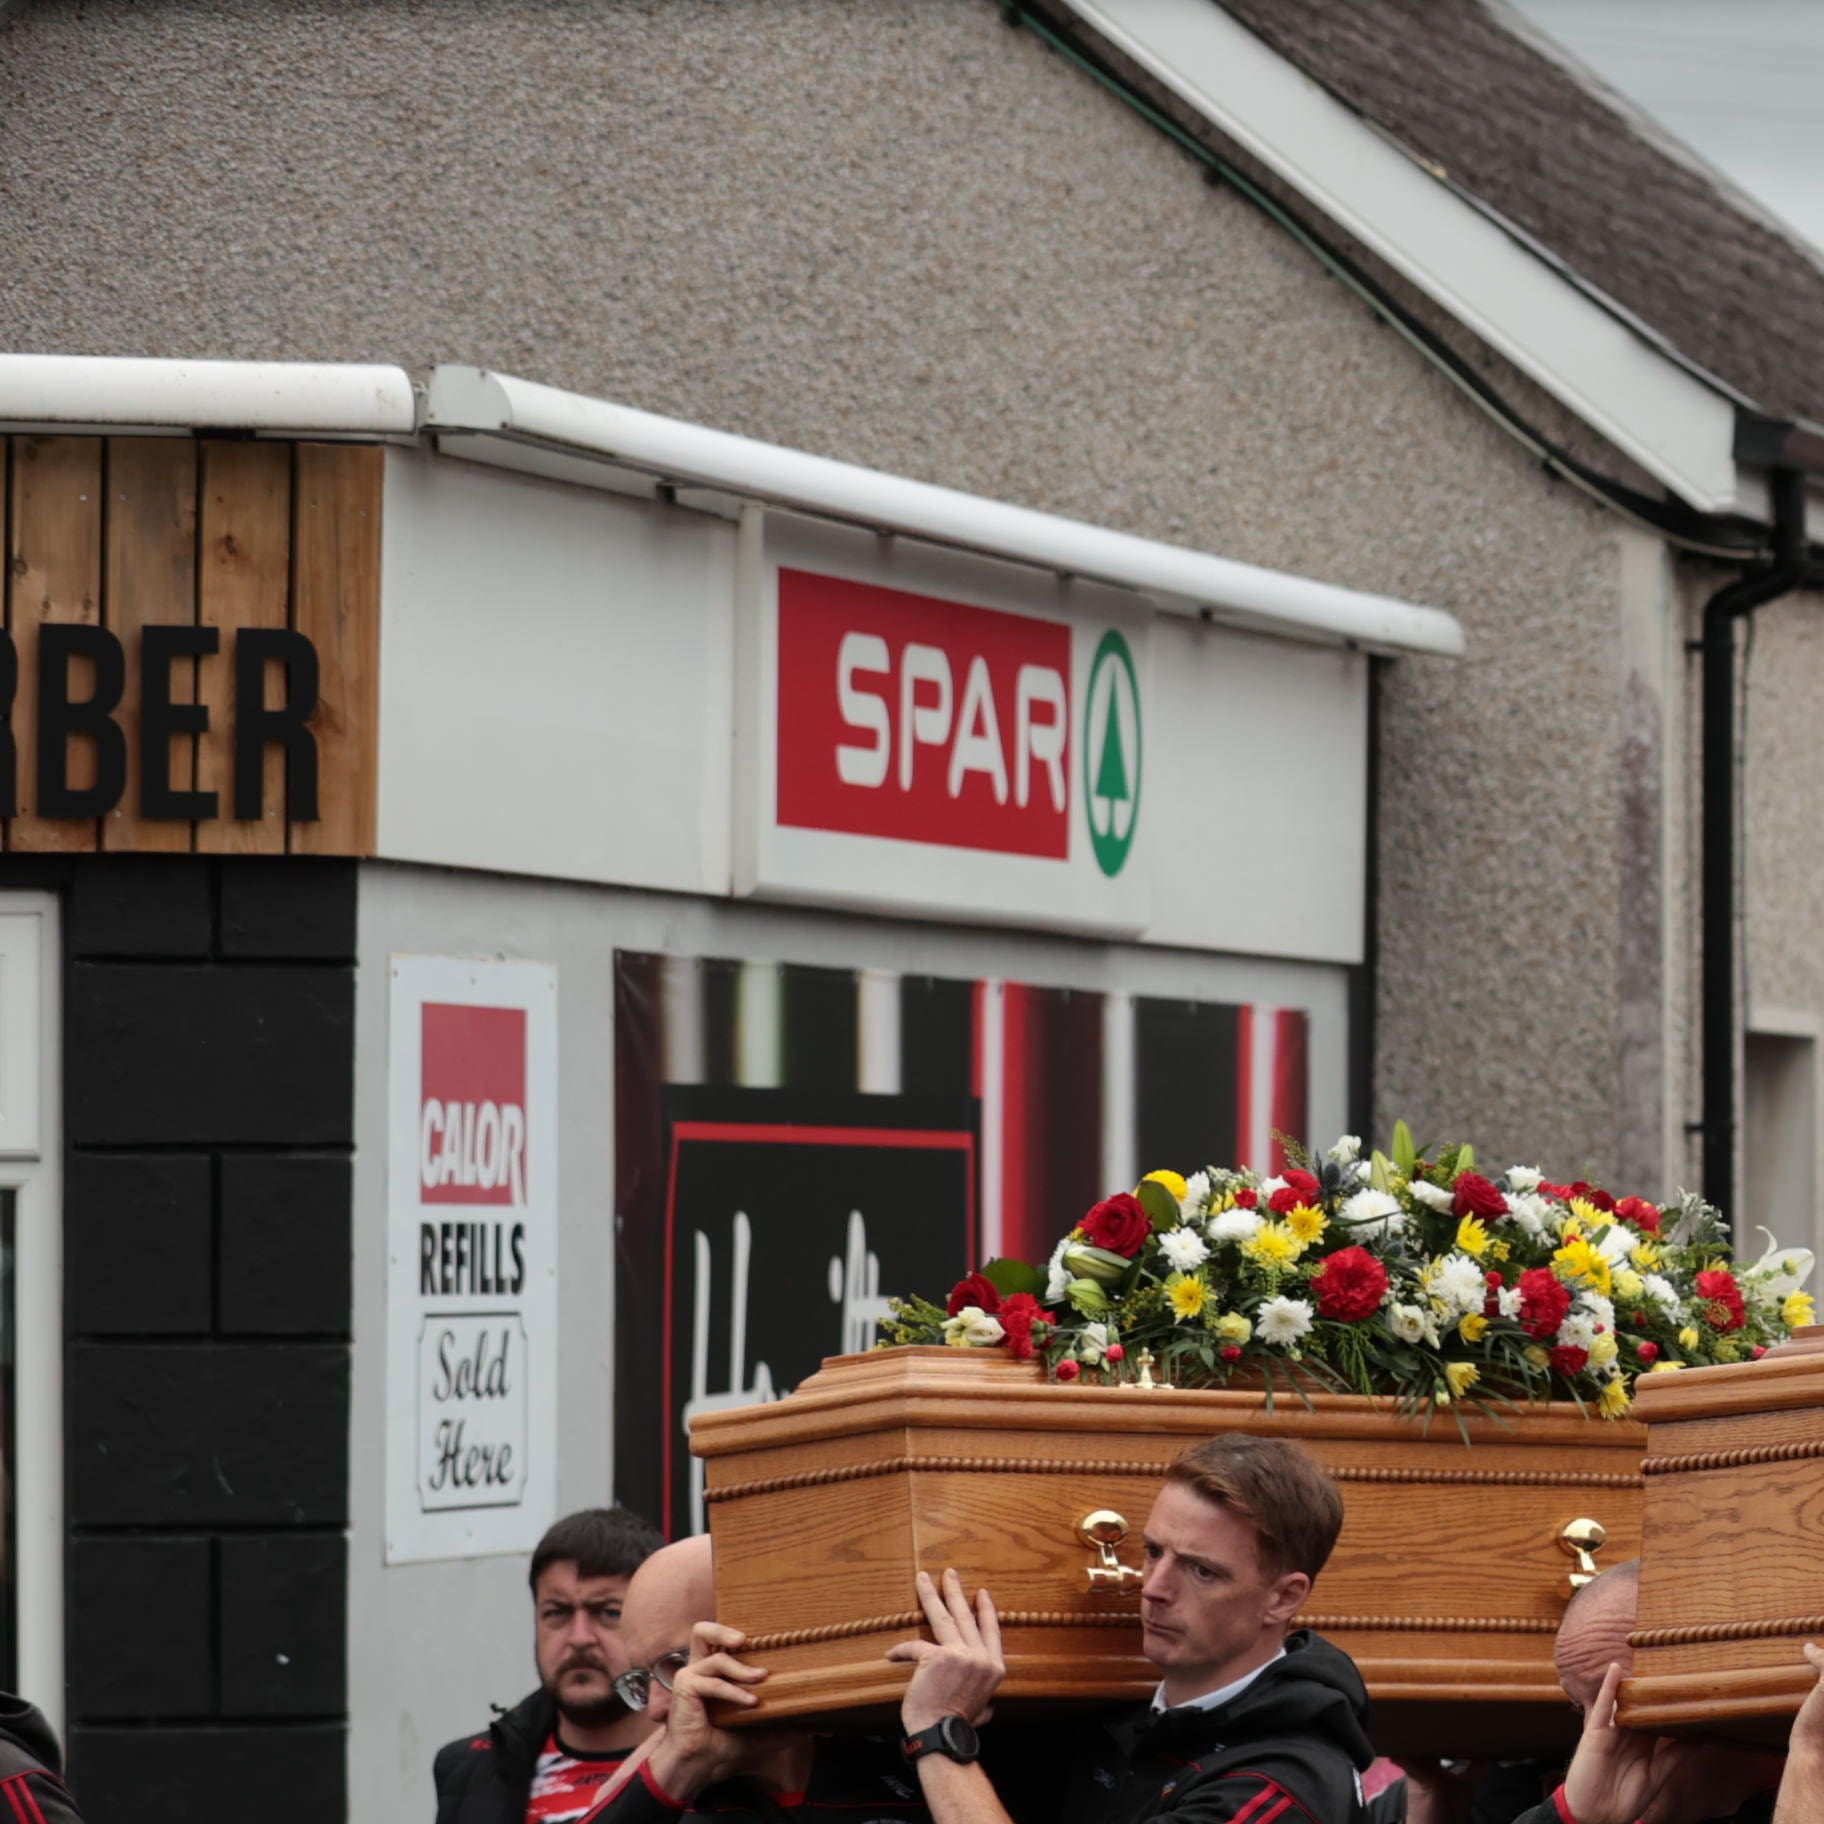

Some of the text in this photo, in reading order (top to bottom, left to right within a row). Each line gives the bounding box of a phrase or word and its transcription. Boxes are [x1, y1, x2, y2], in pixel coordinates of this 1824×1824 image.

[0, 622, 321, 822] BER
[836, 631, 1067, 814] SPAR
[422, 1097, 527, 1206] CALOR
[420, 1223, 525, 1296] REFILLS
[433, 1329, 511, 1402] Sold
[428, 1417, 514, 1491] Here
